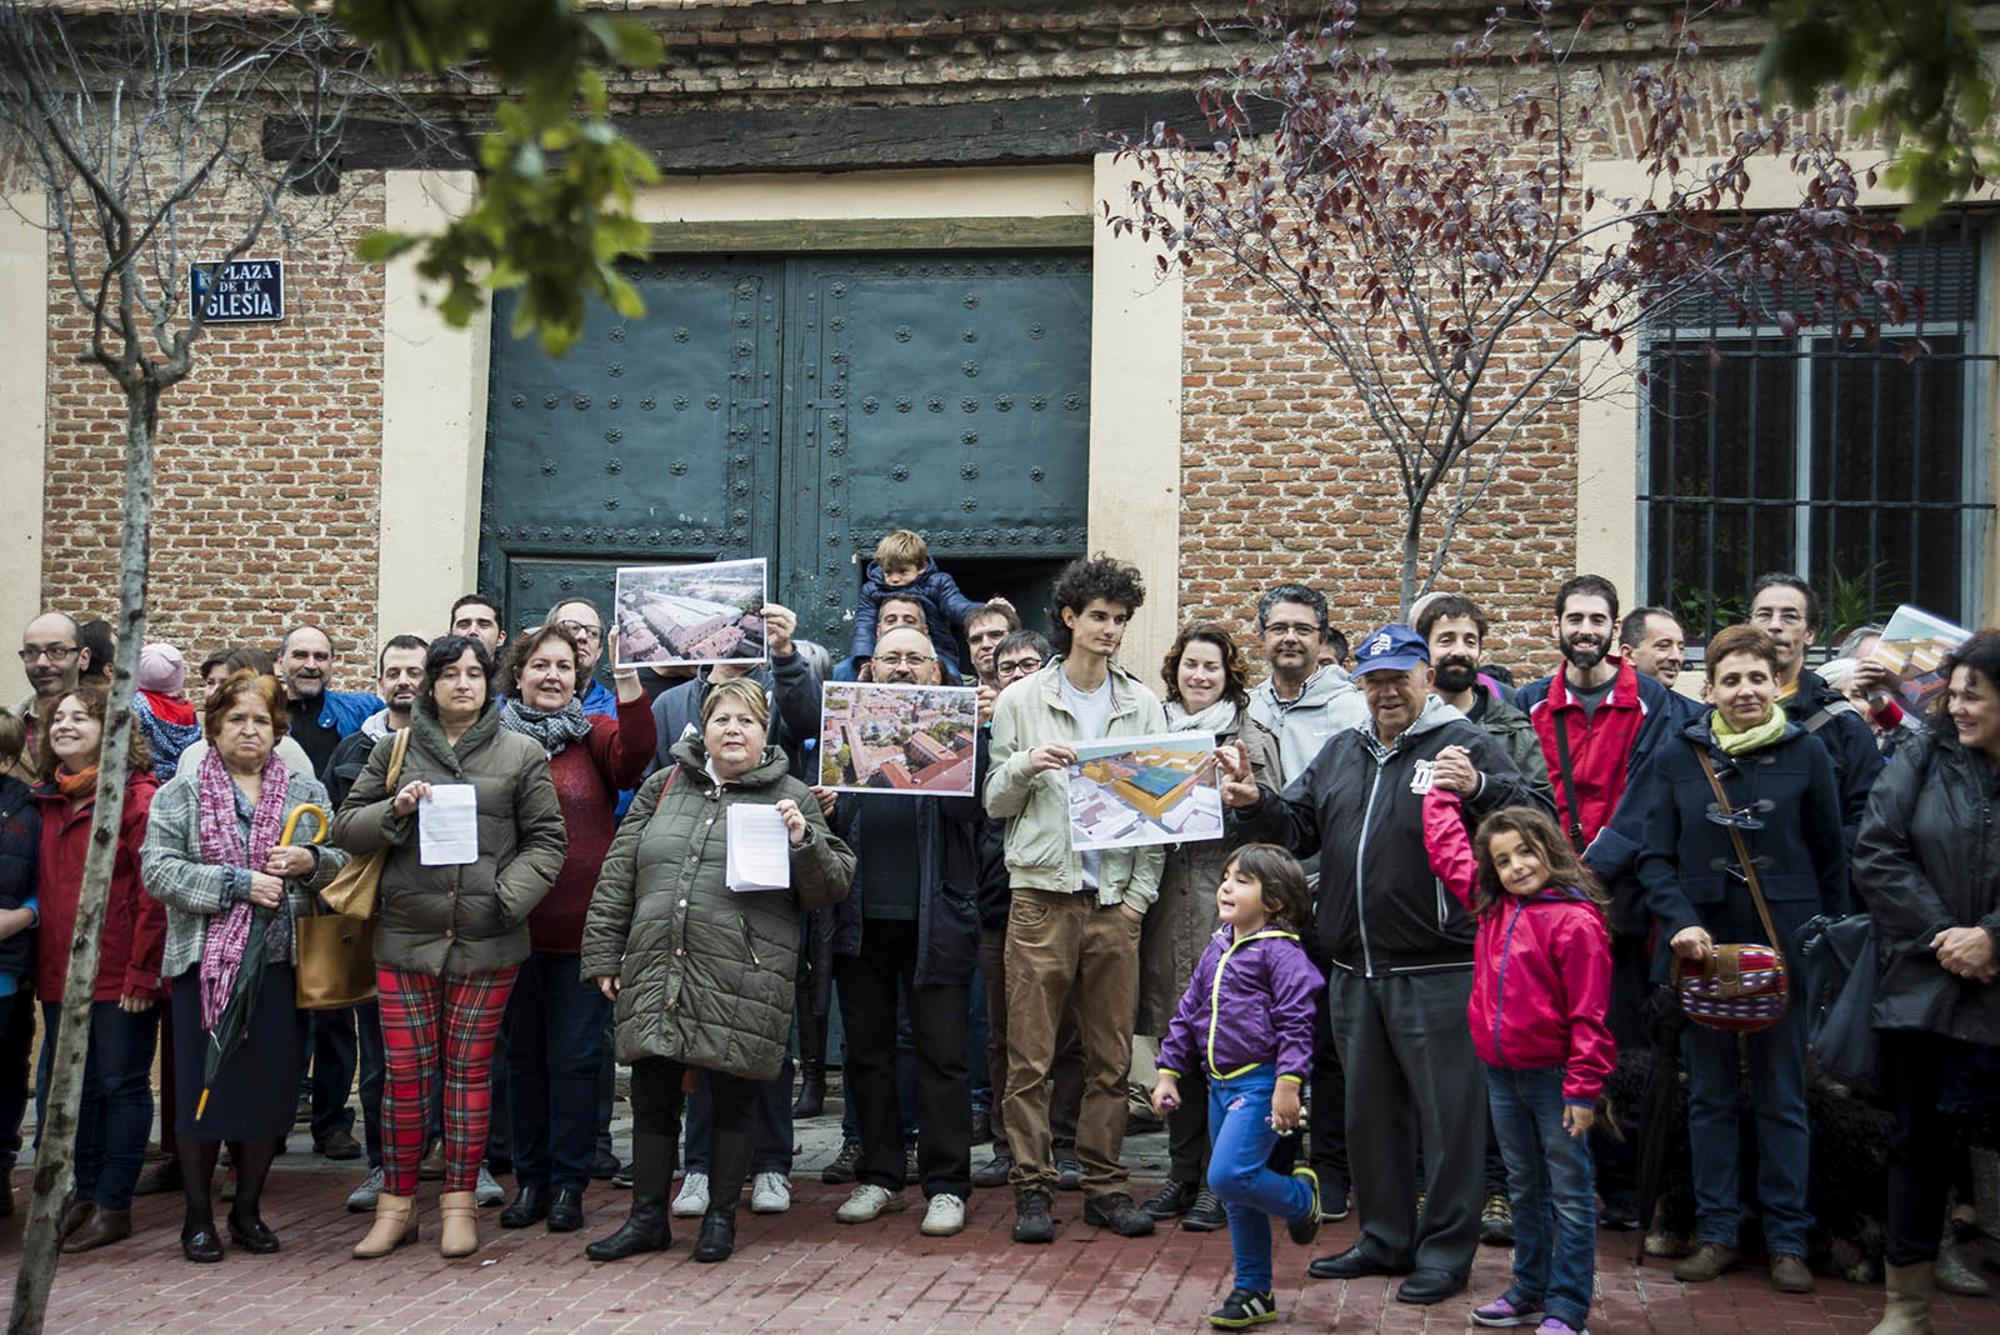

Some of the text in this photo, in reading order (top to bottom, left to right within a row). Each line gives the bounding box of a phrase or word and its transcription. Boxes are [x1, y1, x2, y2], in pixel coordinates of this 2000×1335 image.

[220, 265, 273, 280] PLAZA
[219, 281, 261, 292] DE LA
[200, 293, 273, 316] IGLESIA
